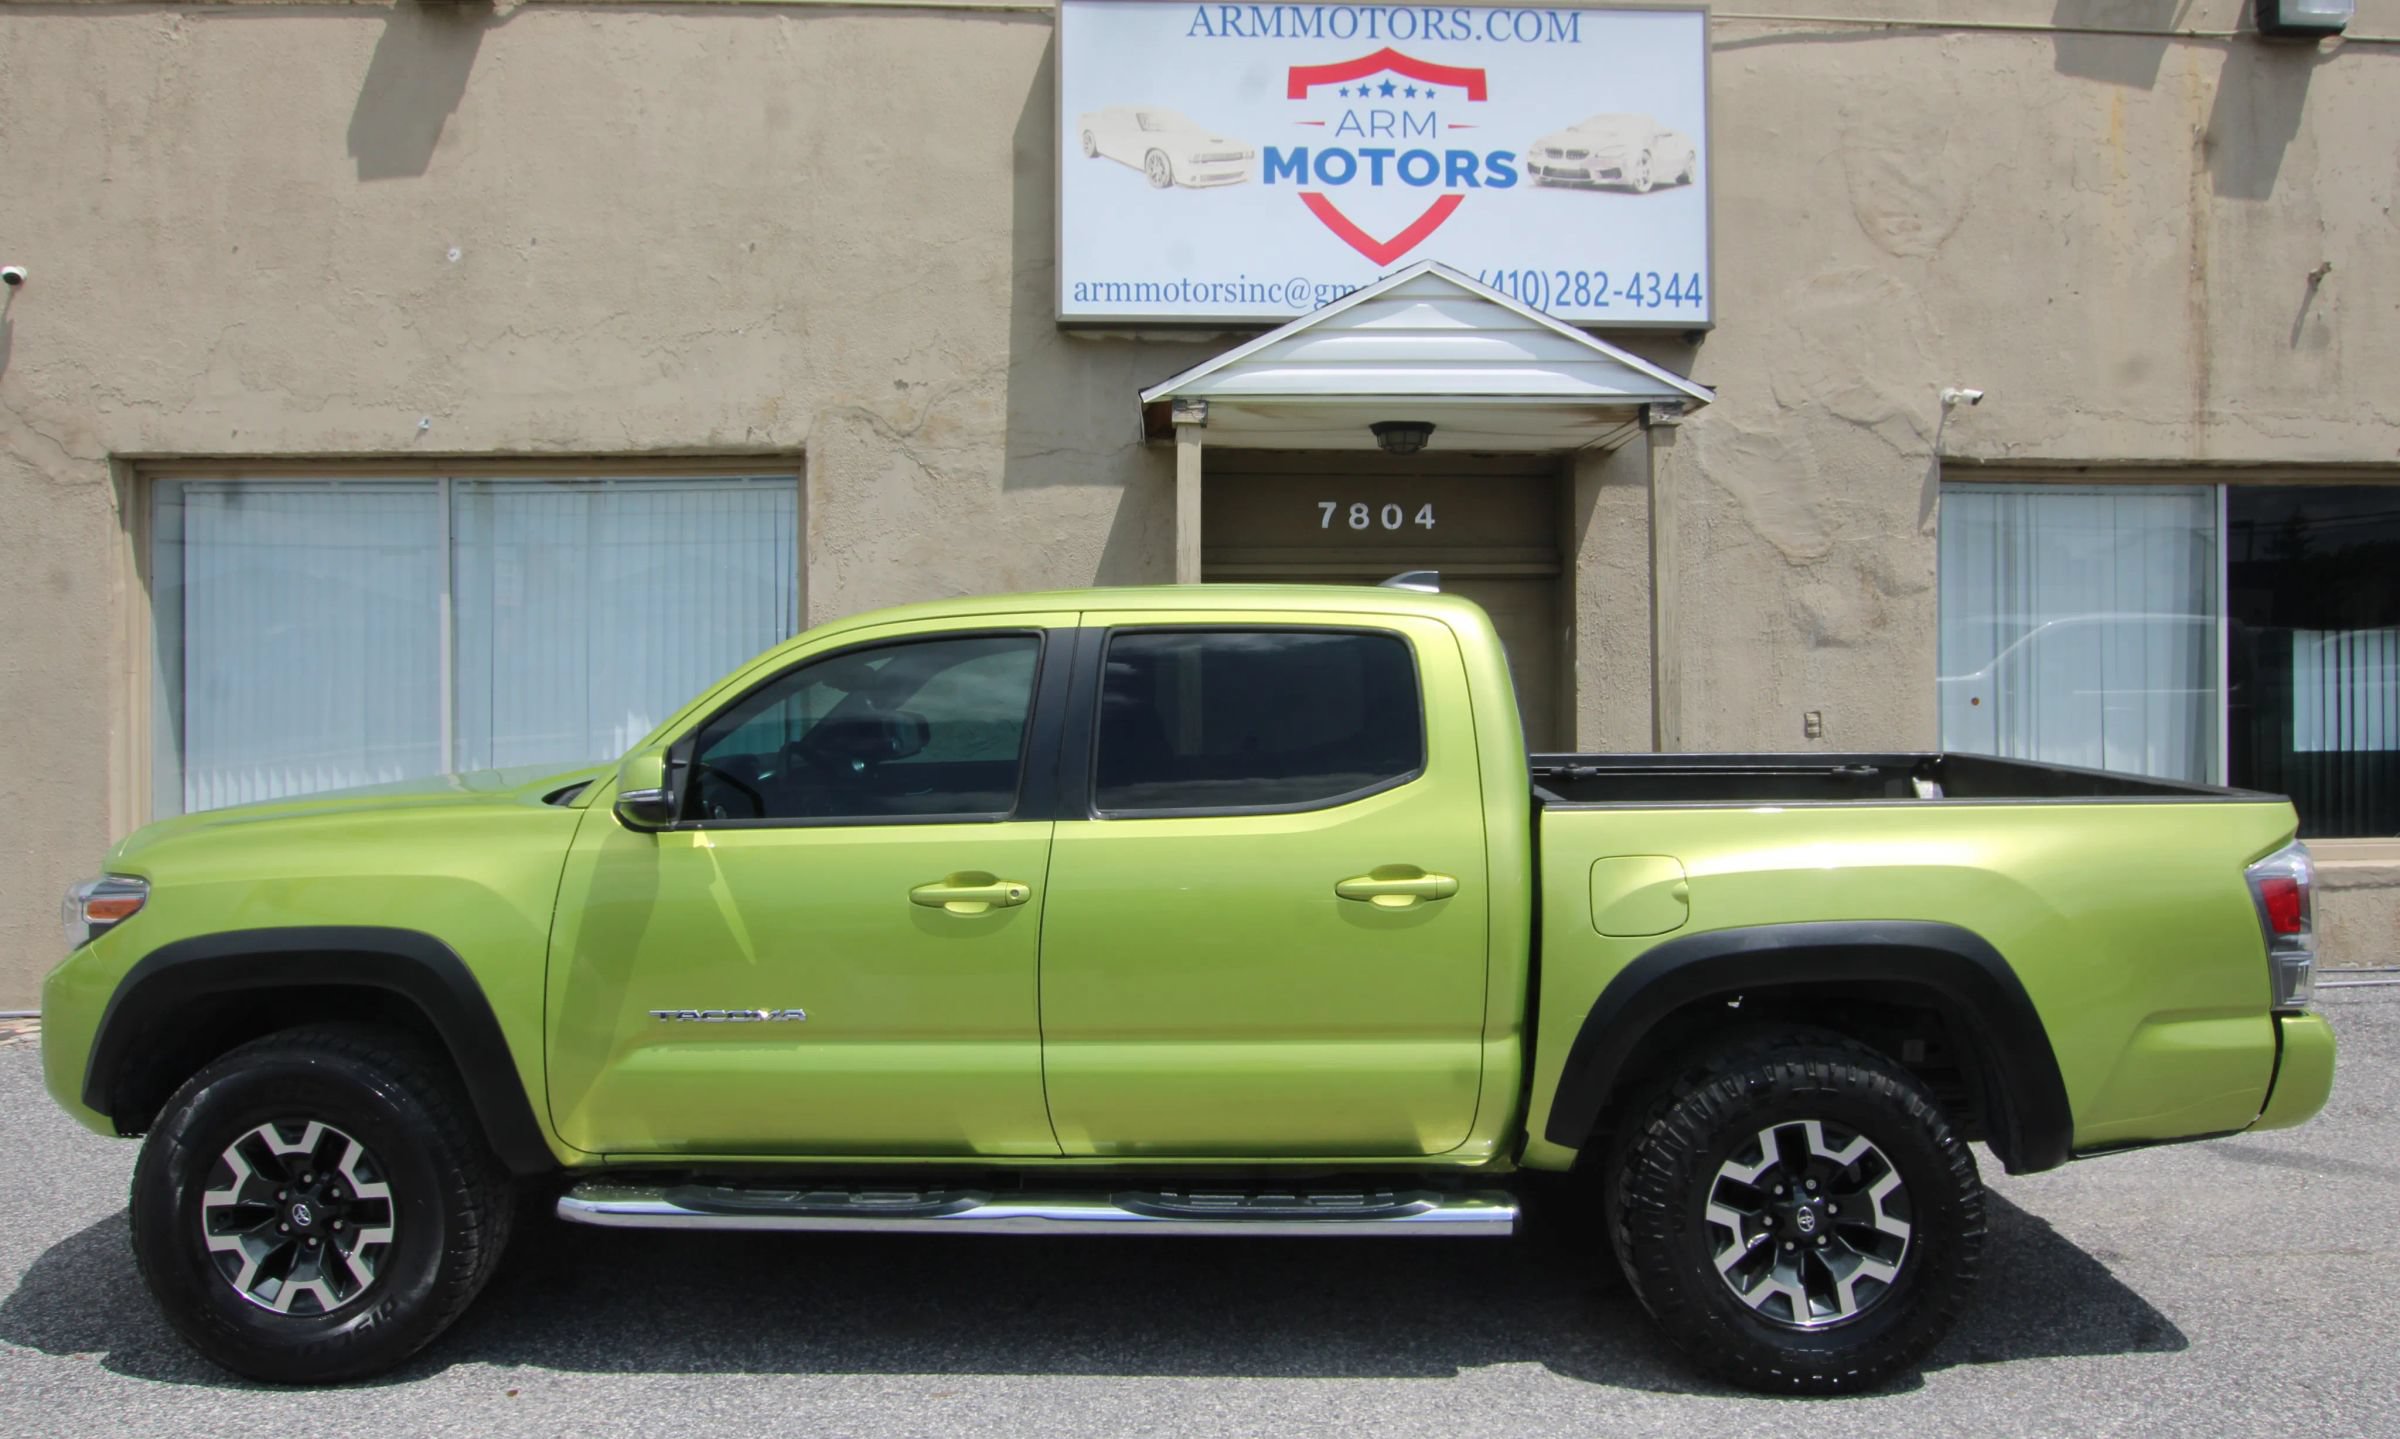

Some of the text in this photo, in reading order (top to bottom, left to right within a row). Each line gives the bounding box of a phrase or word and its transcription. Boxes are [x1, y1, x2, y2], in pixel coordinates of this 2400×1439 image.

[1186, 5, 1582, 43] ARMMOTORS.COM
[1335, 109, 1436, 139] ARM
[1263, 146, 1518, 189] MOTORS
[1318, 501, 1436, 530] 7804
[649, 1008, 806, 1023] TACOMA
